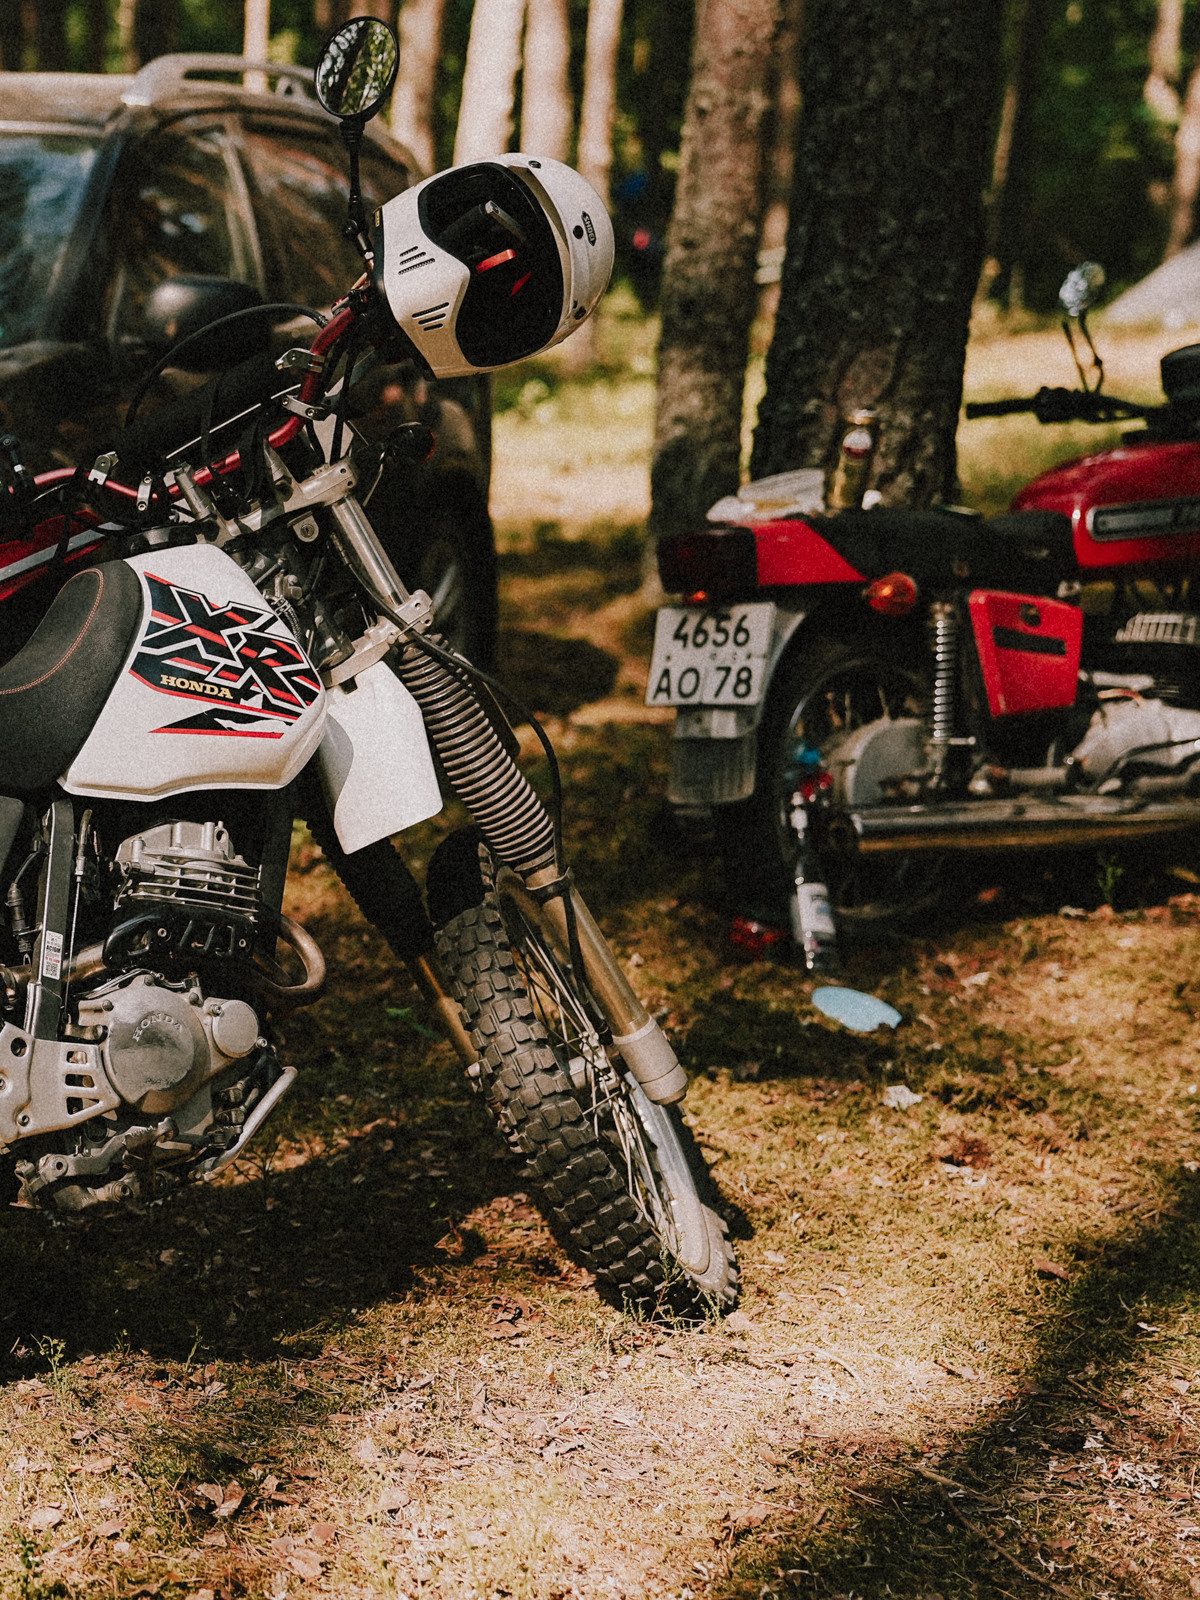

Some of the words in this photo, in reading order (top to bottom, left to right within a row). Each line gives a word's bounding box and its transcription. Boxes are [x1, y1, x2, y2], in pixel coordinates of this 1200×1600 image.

[673, 614, 750, 648] 4656
[160, 674, 234, 700] HONDA
[714, 666, 752, 699] 78
[132, 1012, 183, 1042] HONDA
